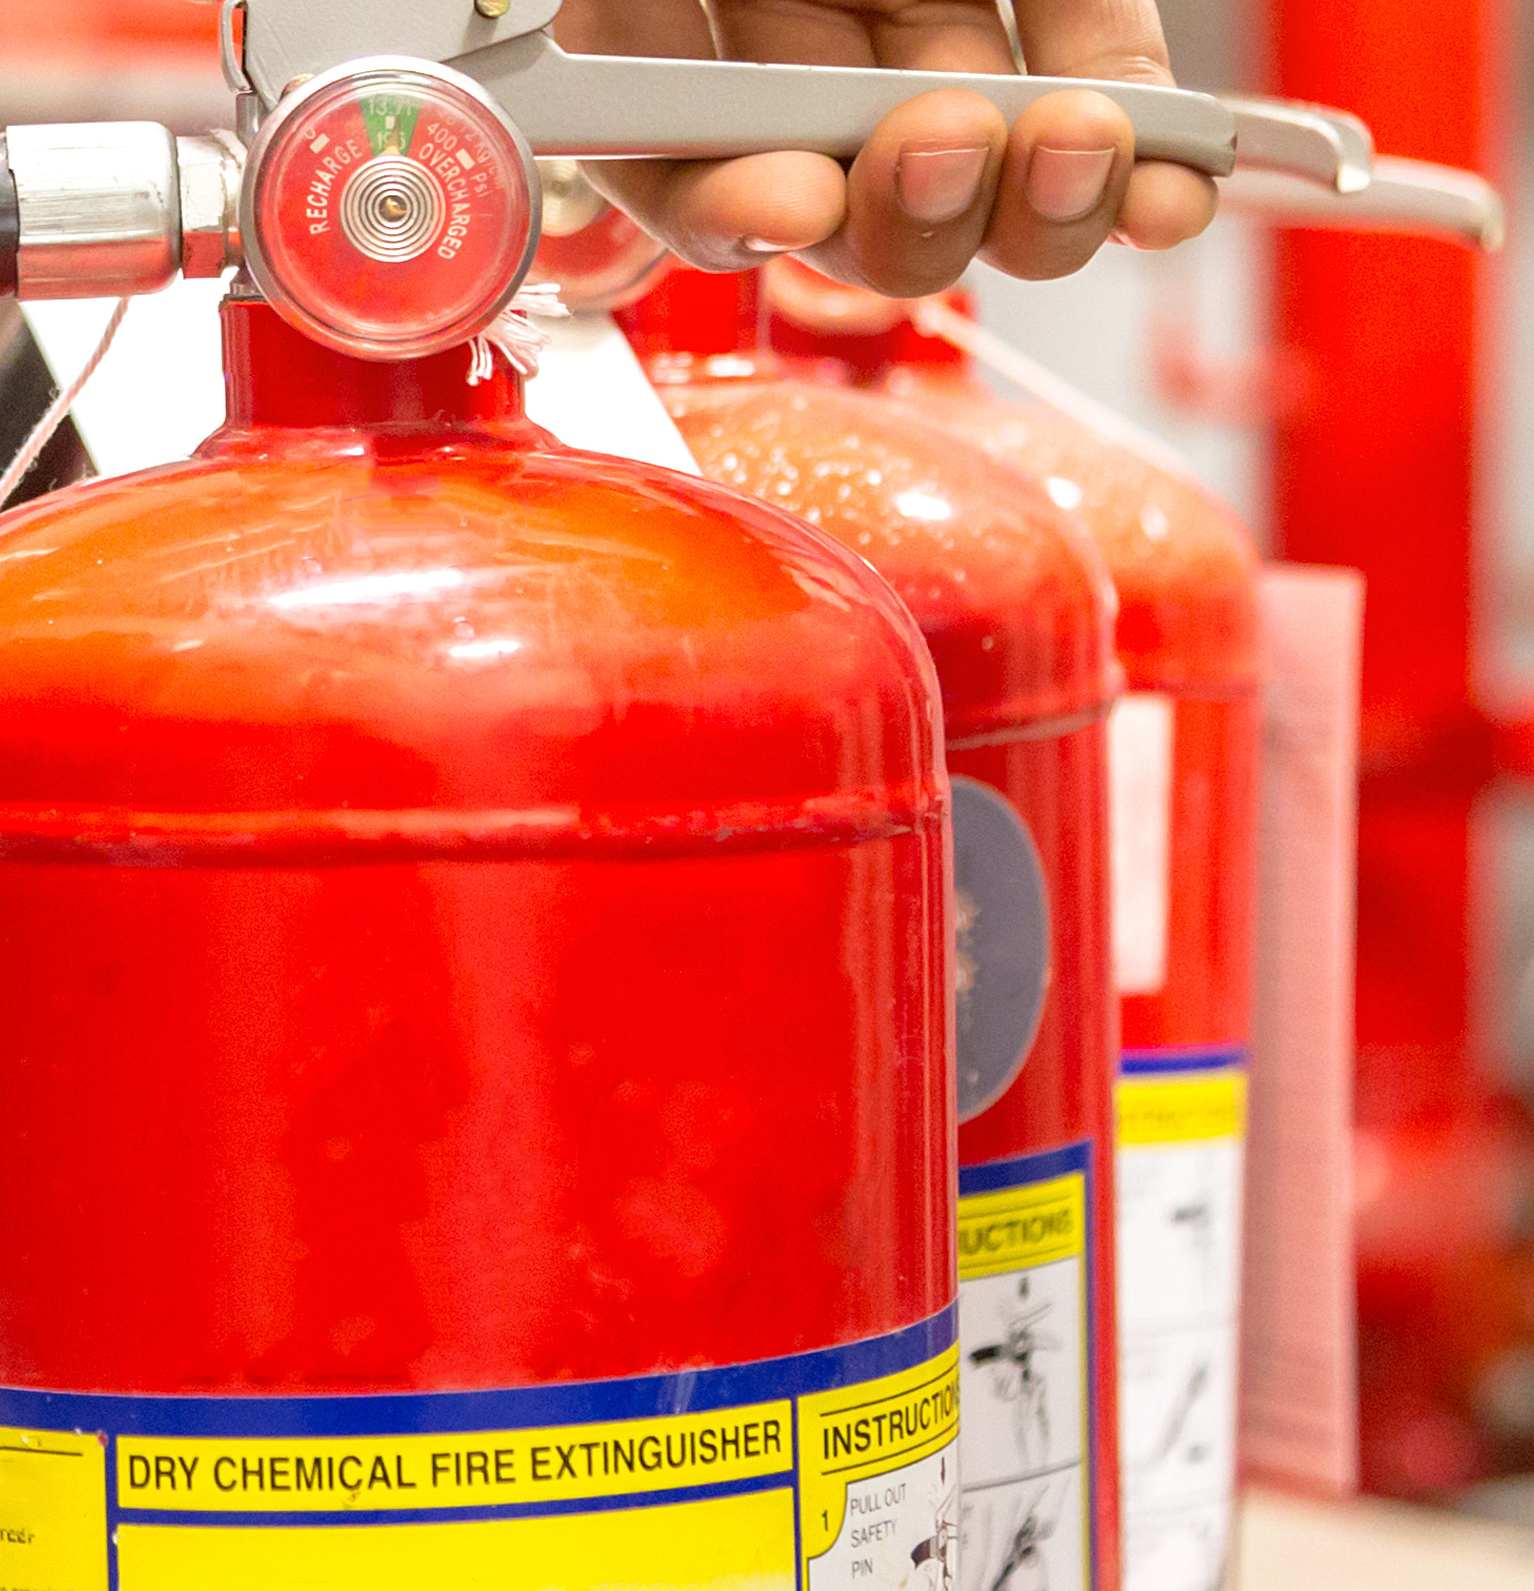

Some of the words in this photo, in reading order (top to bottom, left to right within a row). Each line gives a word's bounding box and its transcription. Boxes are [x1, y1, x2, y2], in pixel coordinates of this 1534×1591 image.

[427, 122, 457, 151] 400
[306, 139, 363, 235] RECHARGE
[419, 143, 471, 259] OVERCHARGED
[959, 1210, 1073, 1255] UCTIONS
[128, 1454, 199, 1491] DRY
[214, 1454, 416, 1492] CHEMICAL
[431, 1449, 516, 1487] FIRE
[531, 1419, 781, 1482] EXTINGUISHER
[821, 1509, 829, 1532] 1
[850, 1493, 882, 1517] PULL
[884, 1483, 906, 1507] OUT
[851, 1519, 897, 1548] SAFETY
[852, 1558, 873, 1579] PIN
